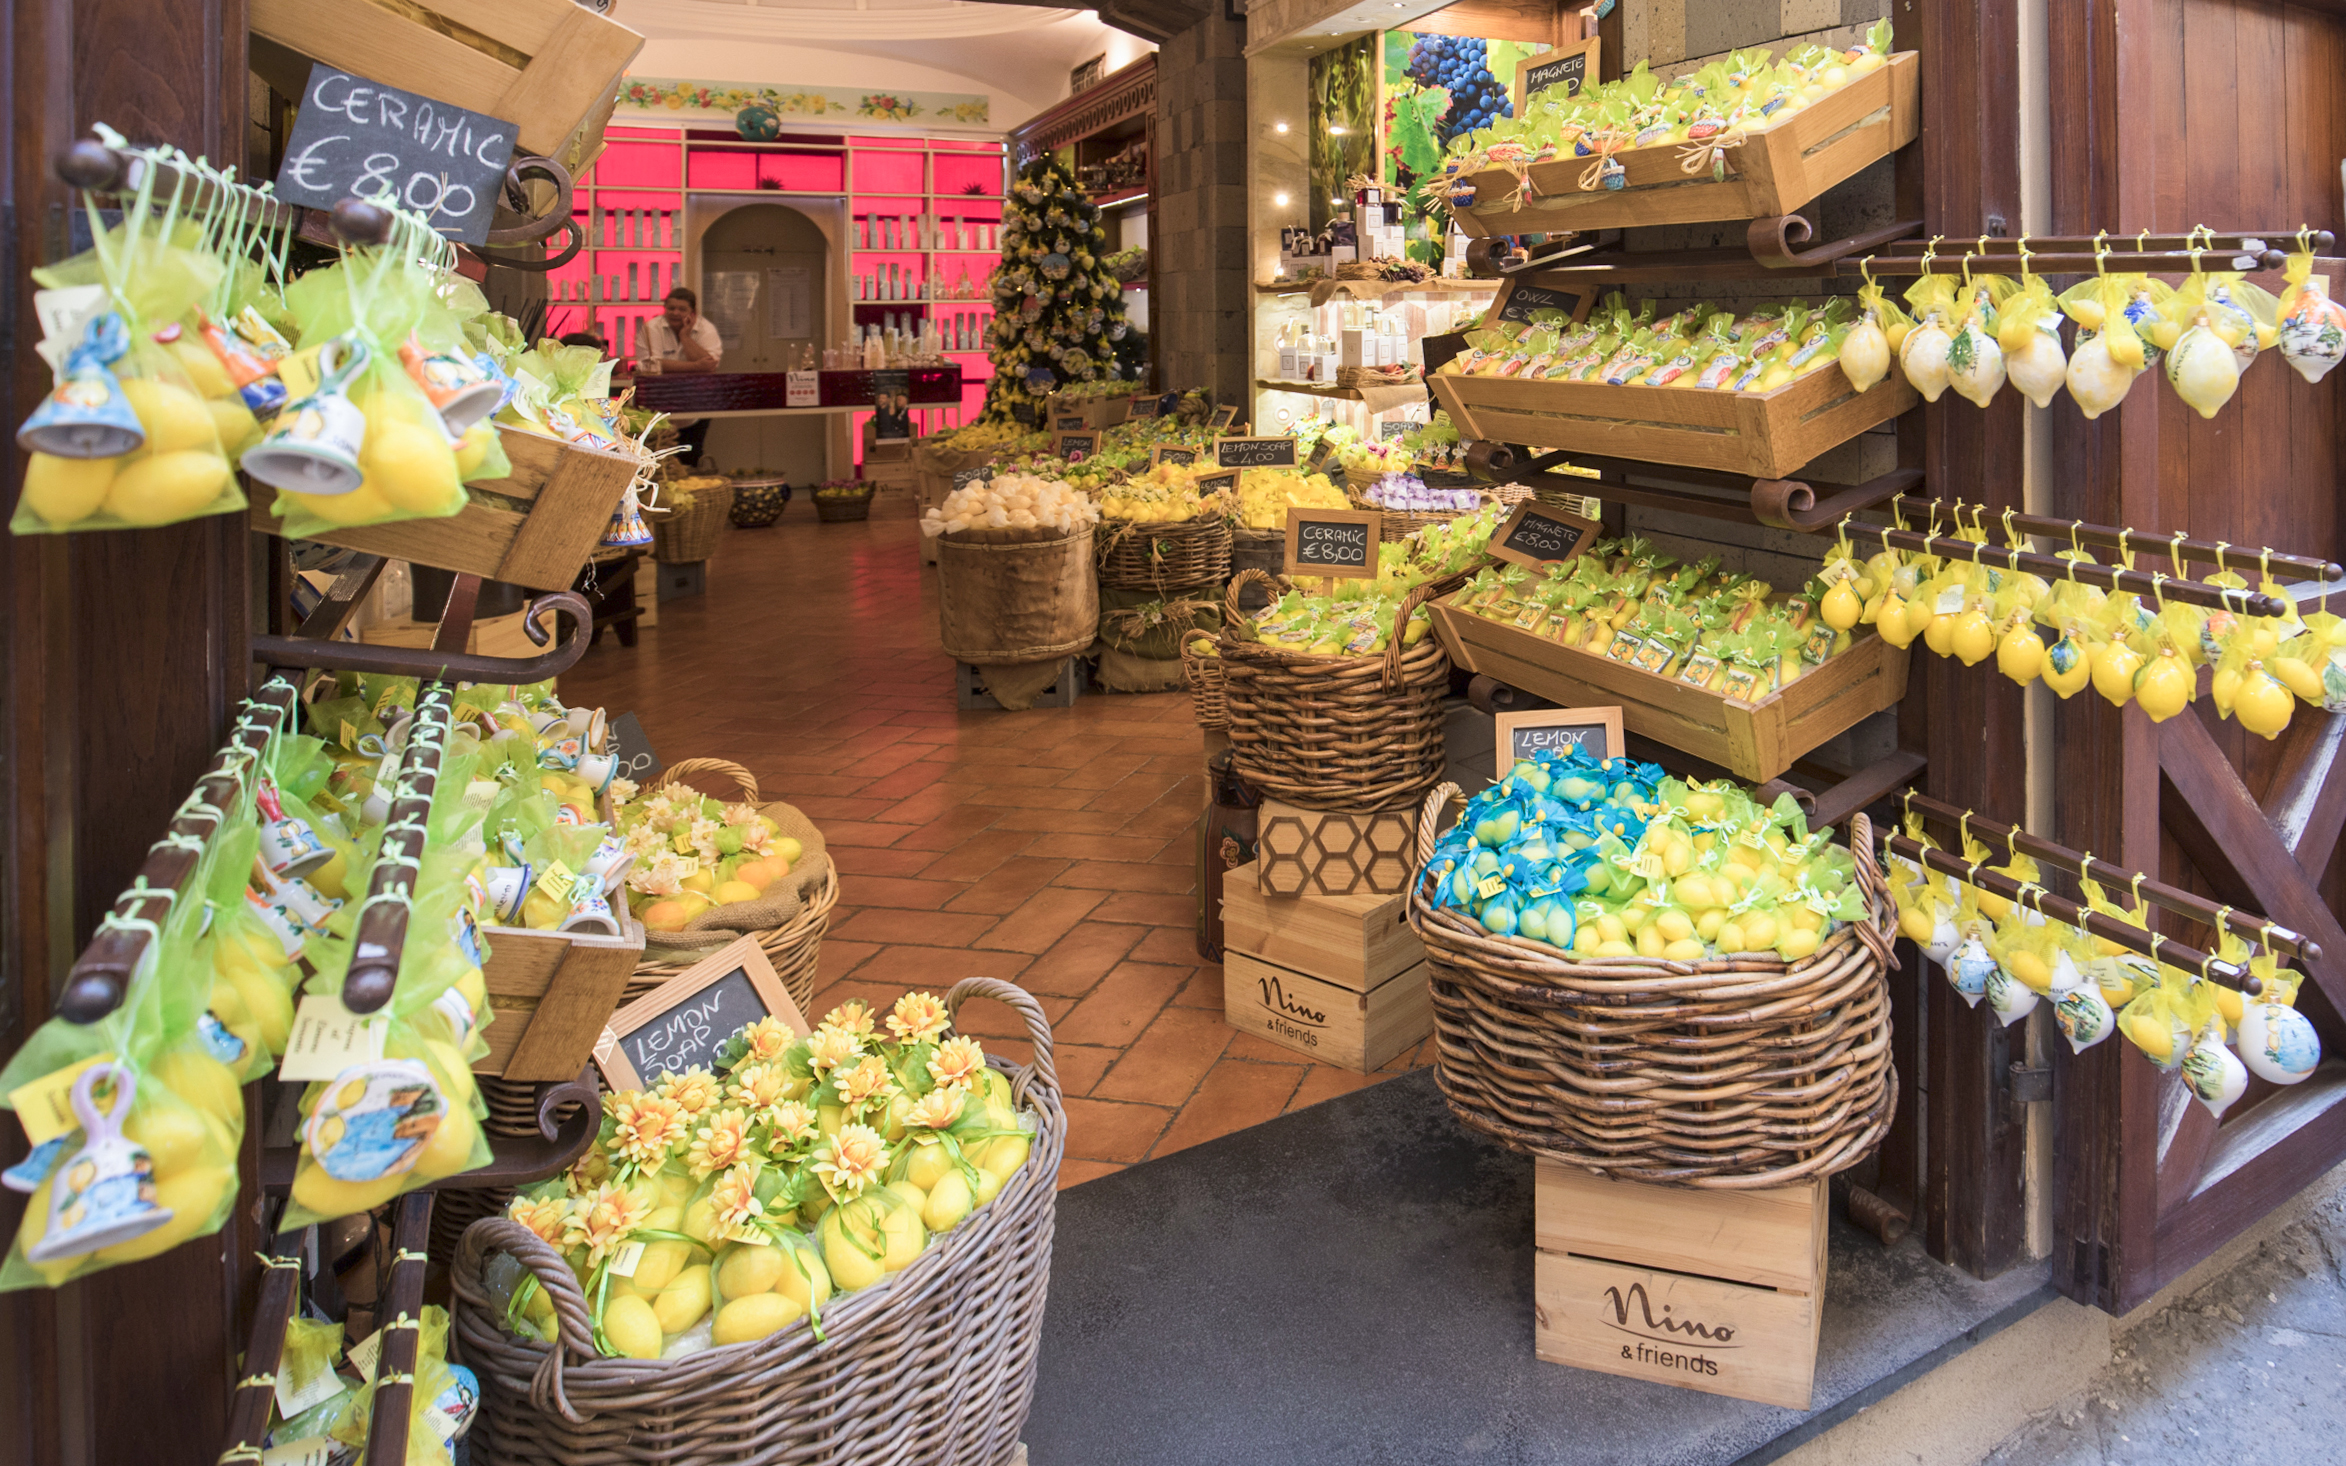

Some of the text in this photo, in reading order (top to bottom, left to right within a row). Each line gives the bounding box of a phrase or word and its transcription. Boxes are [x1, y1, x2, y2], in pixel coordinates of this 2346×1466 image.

[1530, 57, 1584, 84] MAGNETE
[312, 75, 506, 170] CERAMIC
[1516, 289, 1555, 305] OWL
[1163, 450, 1194, 462] SOAP
[1221, 441, 1292, 454] LEMON SOAP
[954, 467, 989, 483] SOAP
[1521, 730, 1588, 747] LEMON
[1257, 976, 1326, 1023] Nino
[636, 989, 724, 1066] LEMON
[1275, 1018, 1319, 1047] friends
[644, 1025, 711, 1082] SOAP
[1603, 1282, 1735, 1342] Nino
[1620, 1342, 1719, 1376] & friends
